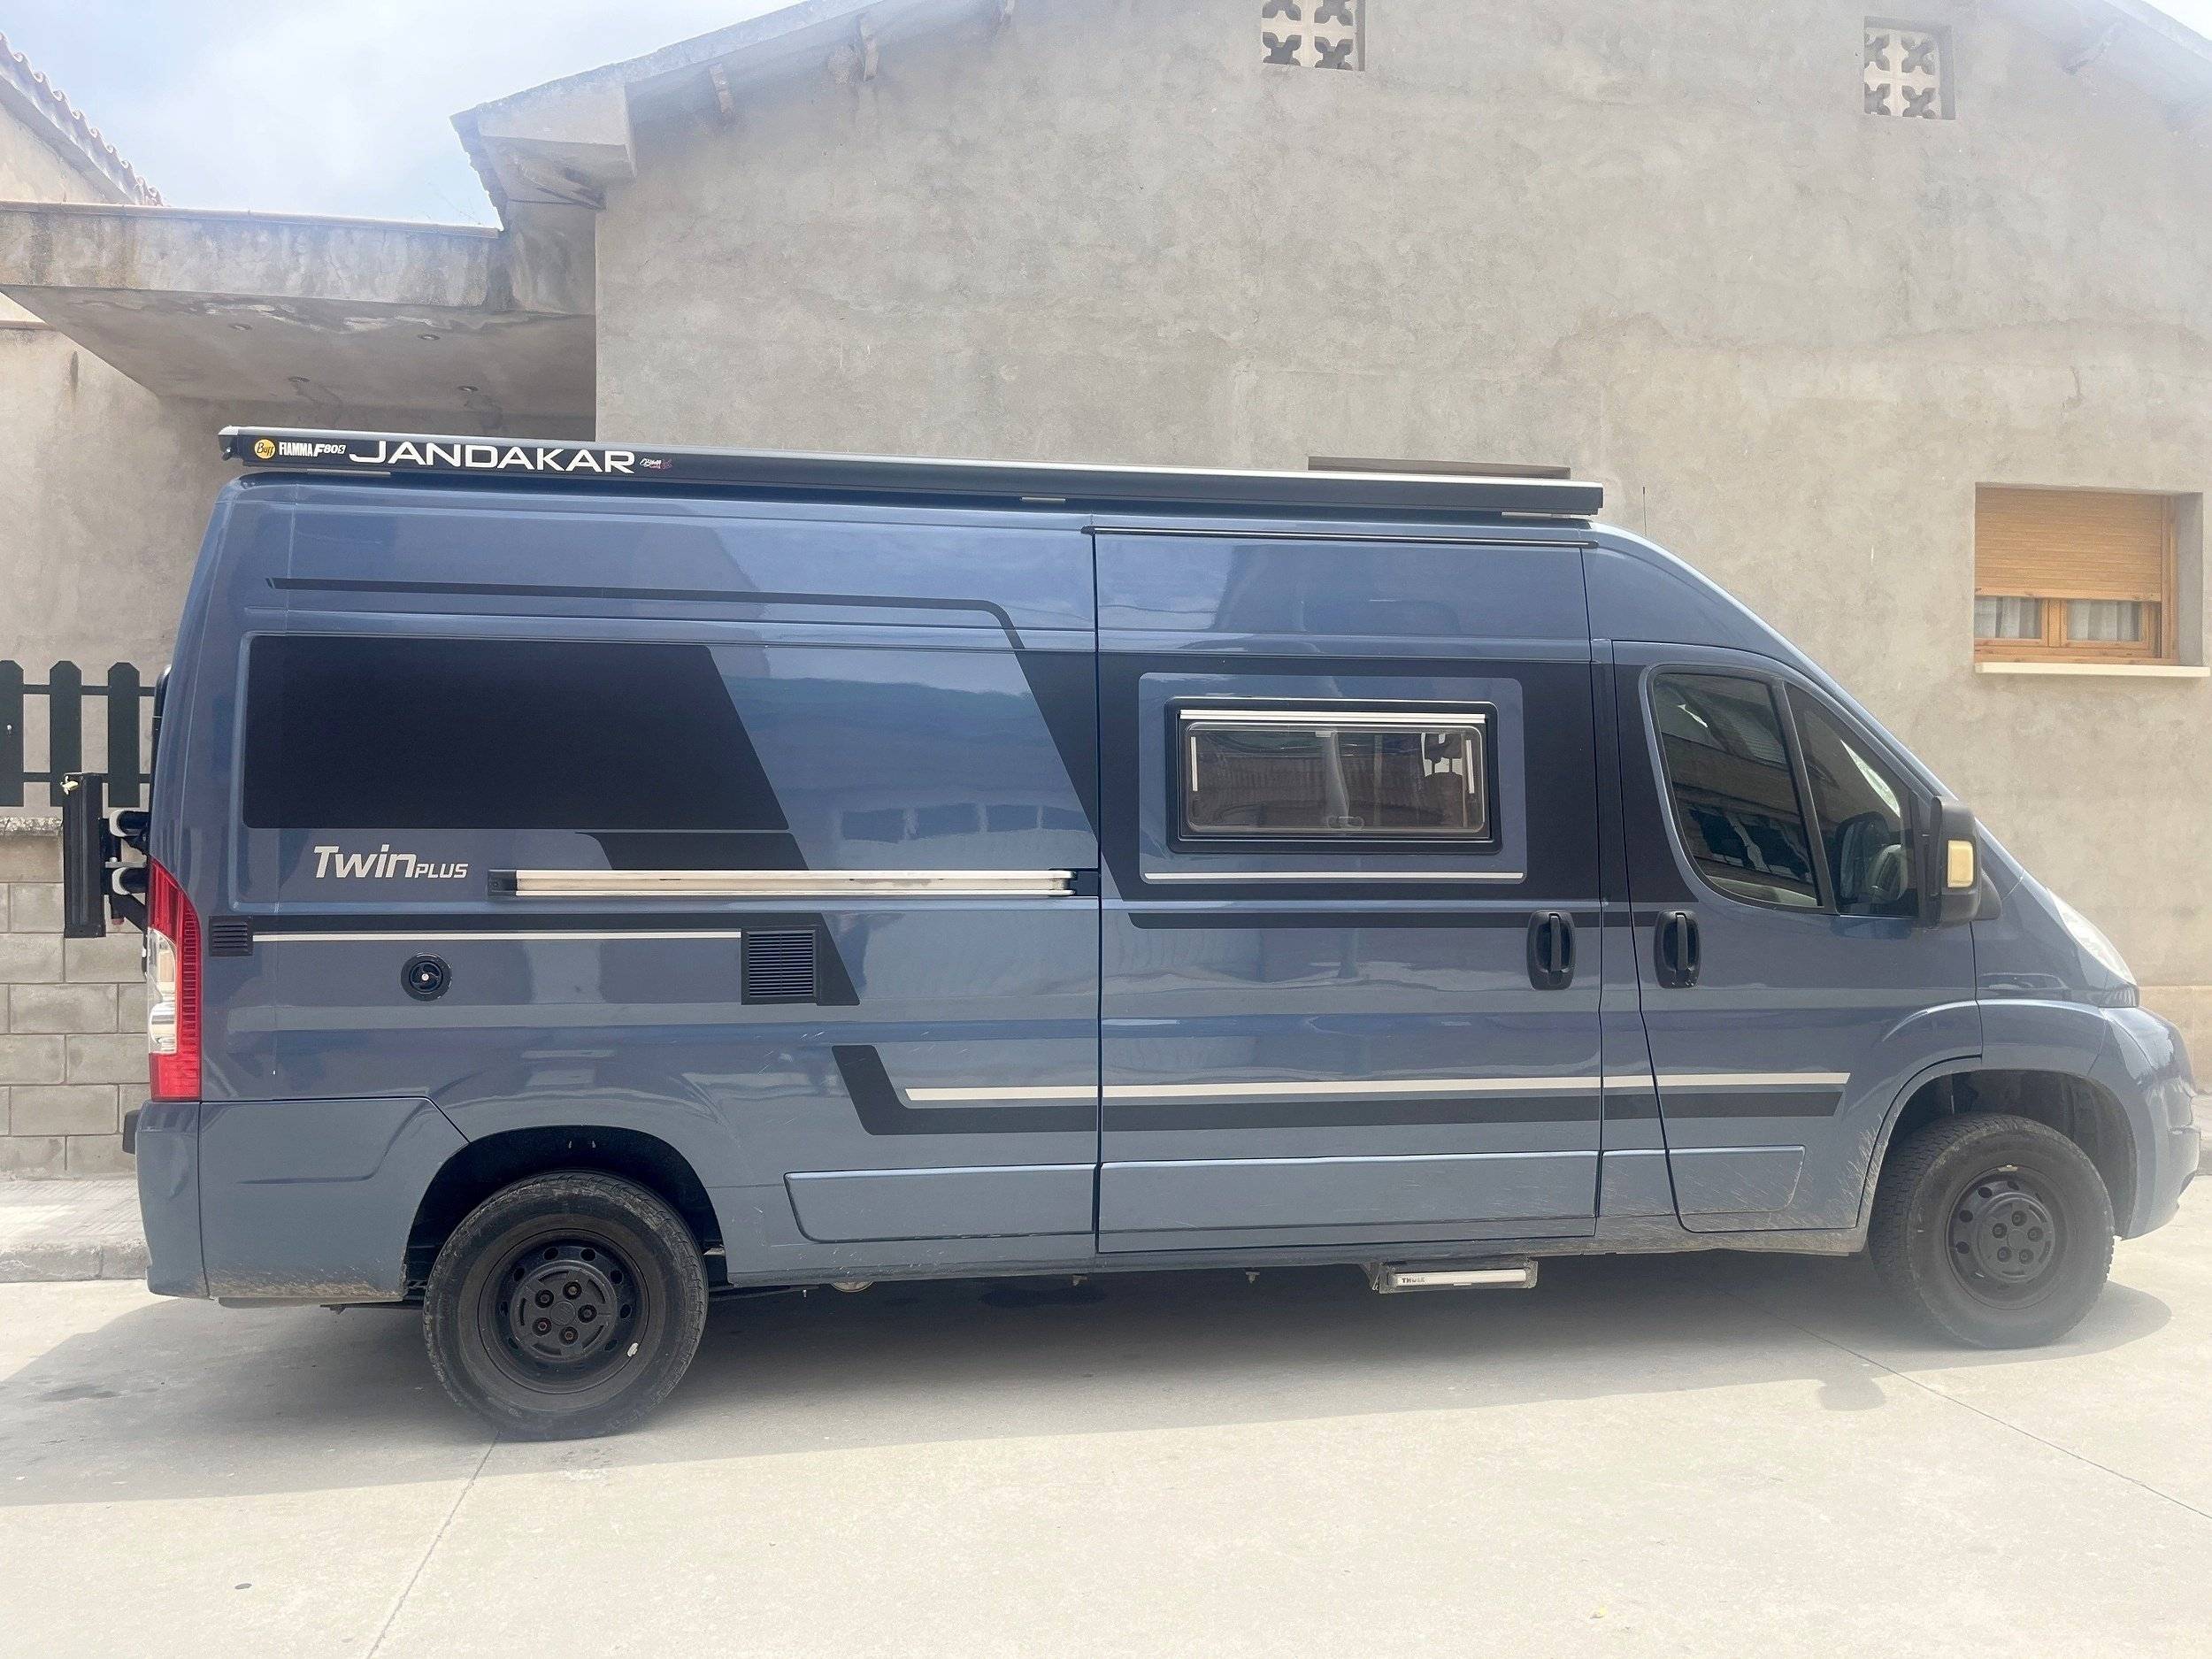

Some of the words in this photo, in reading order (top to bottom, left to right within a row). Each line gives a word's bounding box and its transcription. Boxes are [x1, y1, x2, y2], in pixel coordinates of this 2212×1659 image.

[257, 442, 275, 457] Buff
[279, 442, 313, 457] FIAMMA
[349, 440, 635, 473] JANDAKAR
[313, 843, 417, 879] Twin
[414, 863, 469, 879] PLUS
